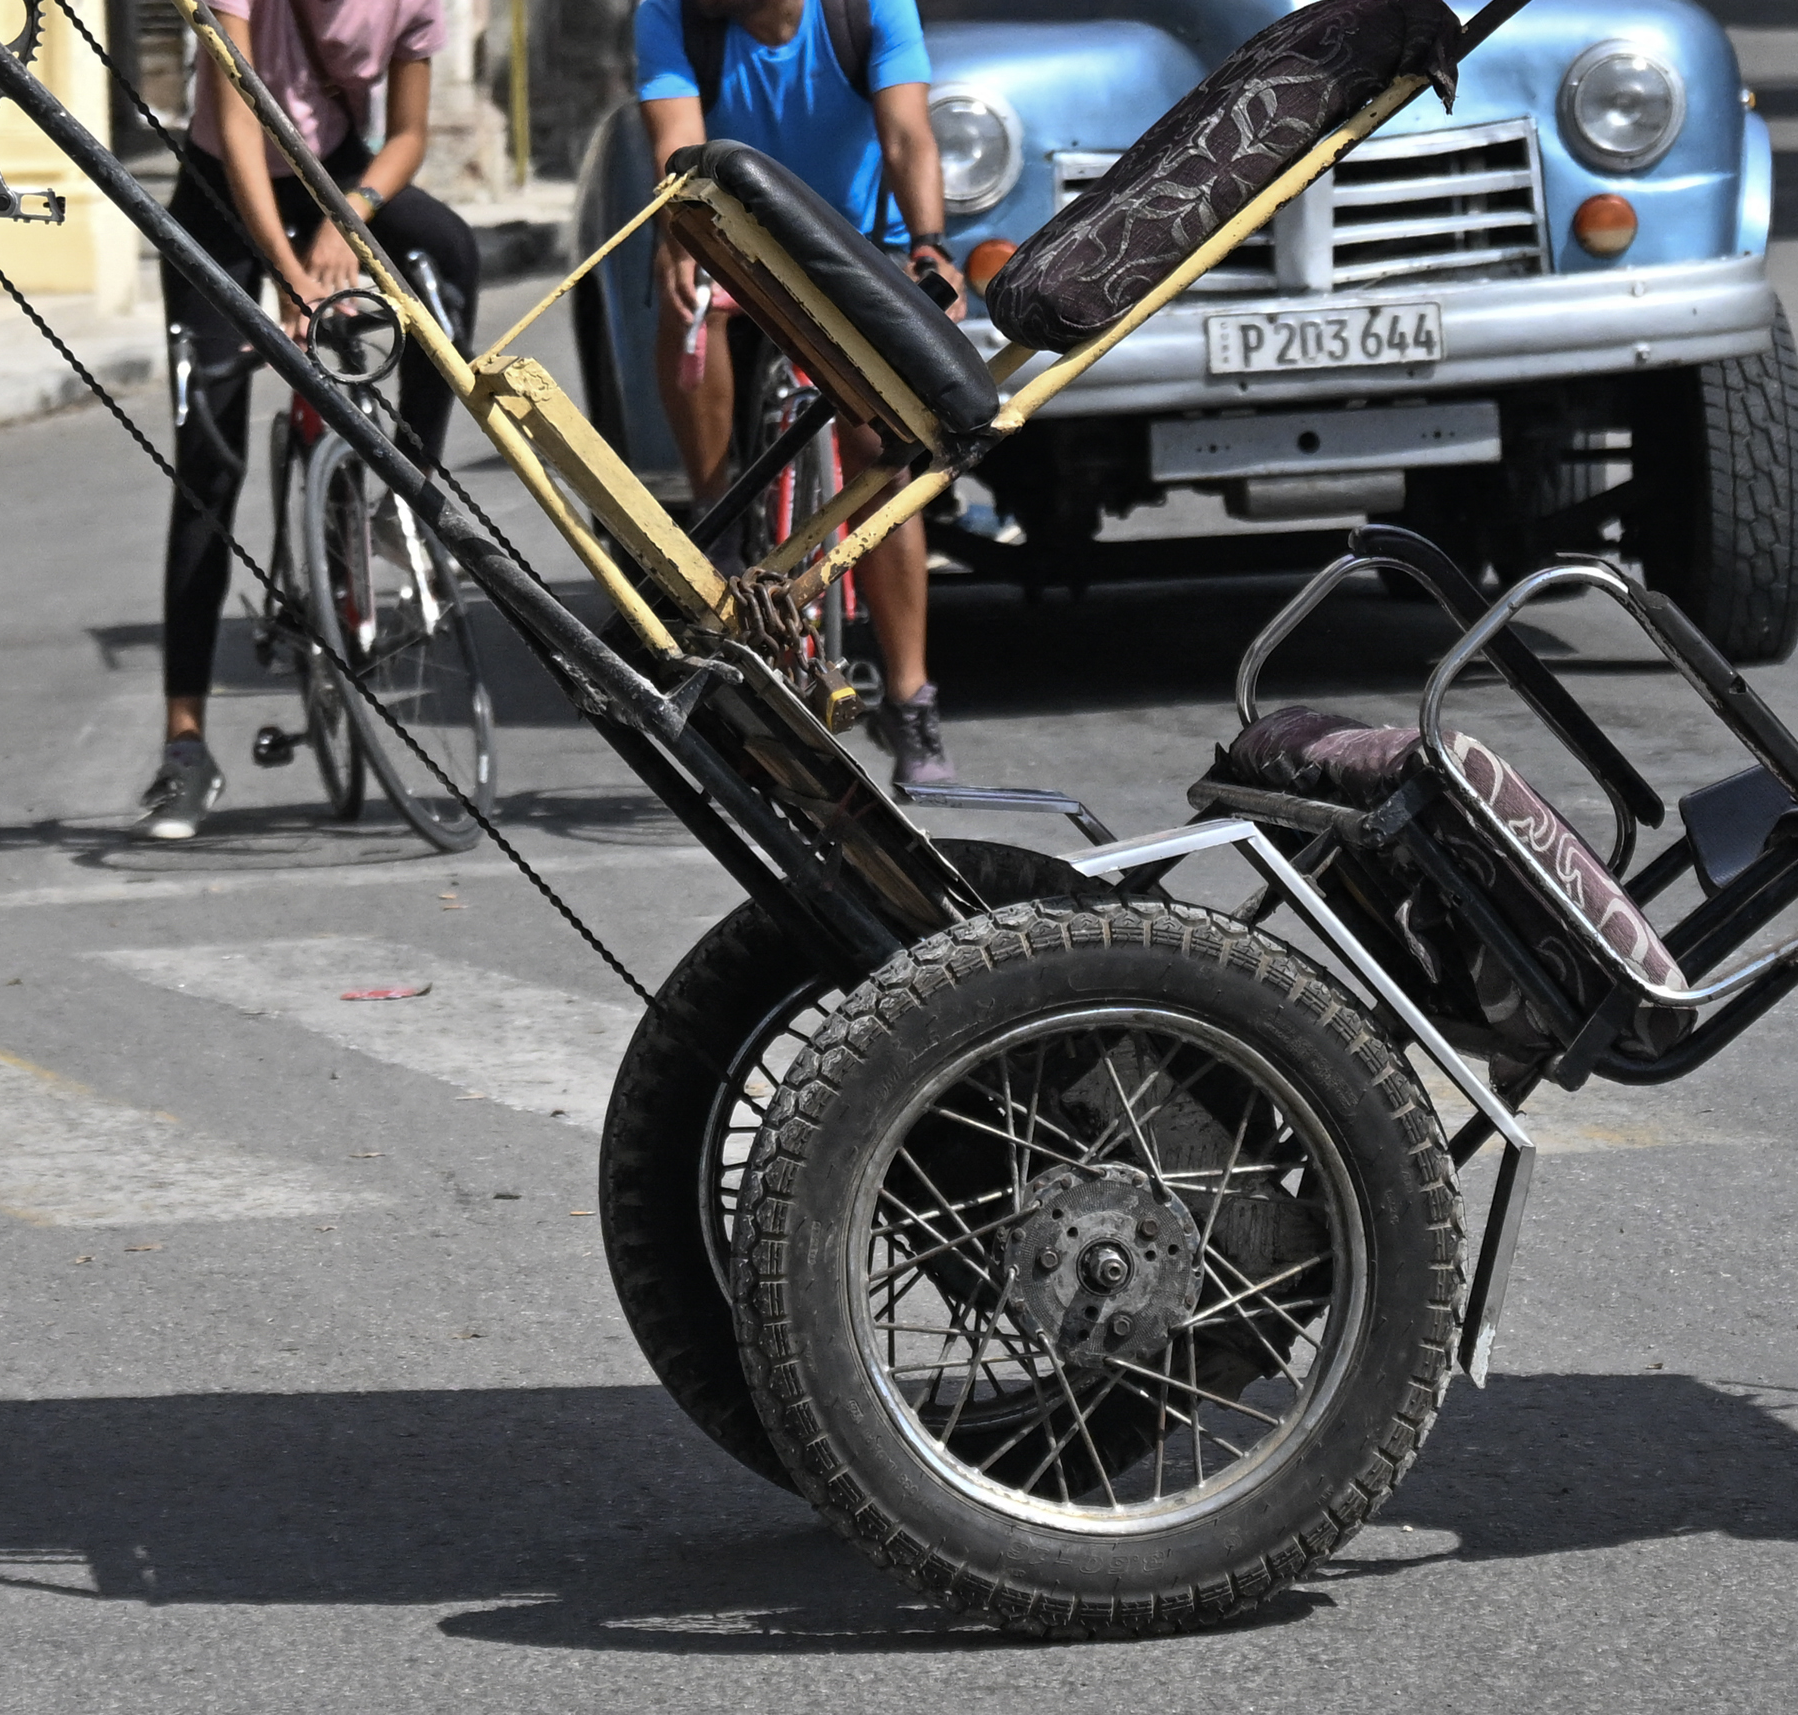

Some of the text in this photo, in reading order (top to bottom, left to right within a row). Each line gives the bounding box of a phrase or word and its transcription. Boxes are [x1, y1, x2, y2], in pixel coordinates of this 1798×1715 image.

[1239, 324, 1265, 369] P
[1273, 318, 1350, 366] 203
[1360, 310, 1437, 360] 644
